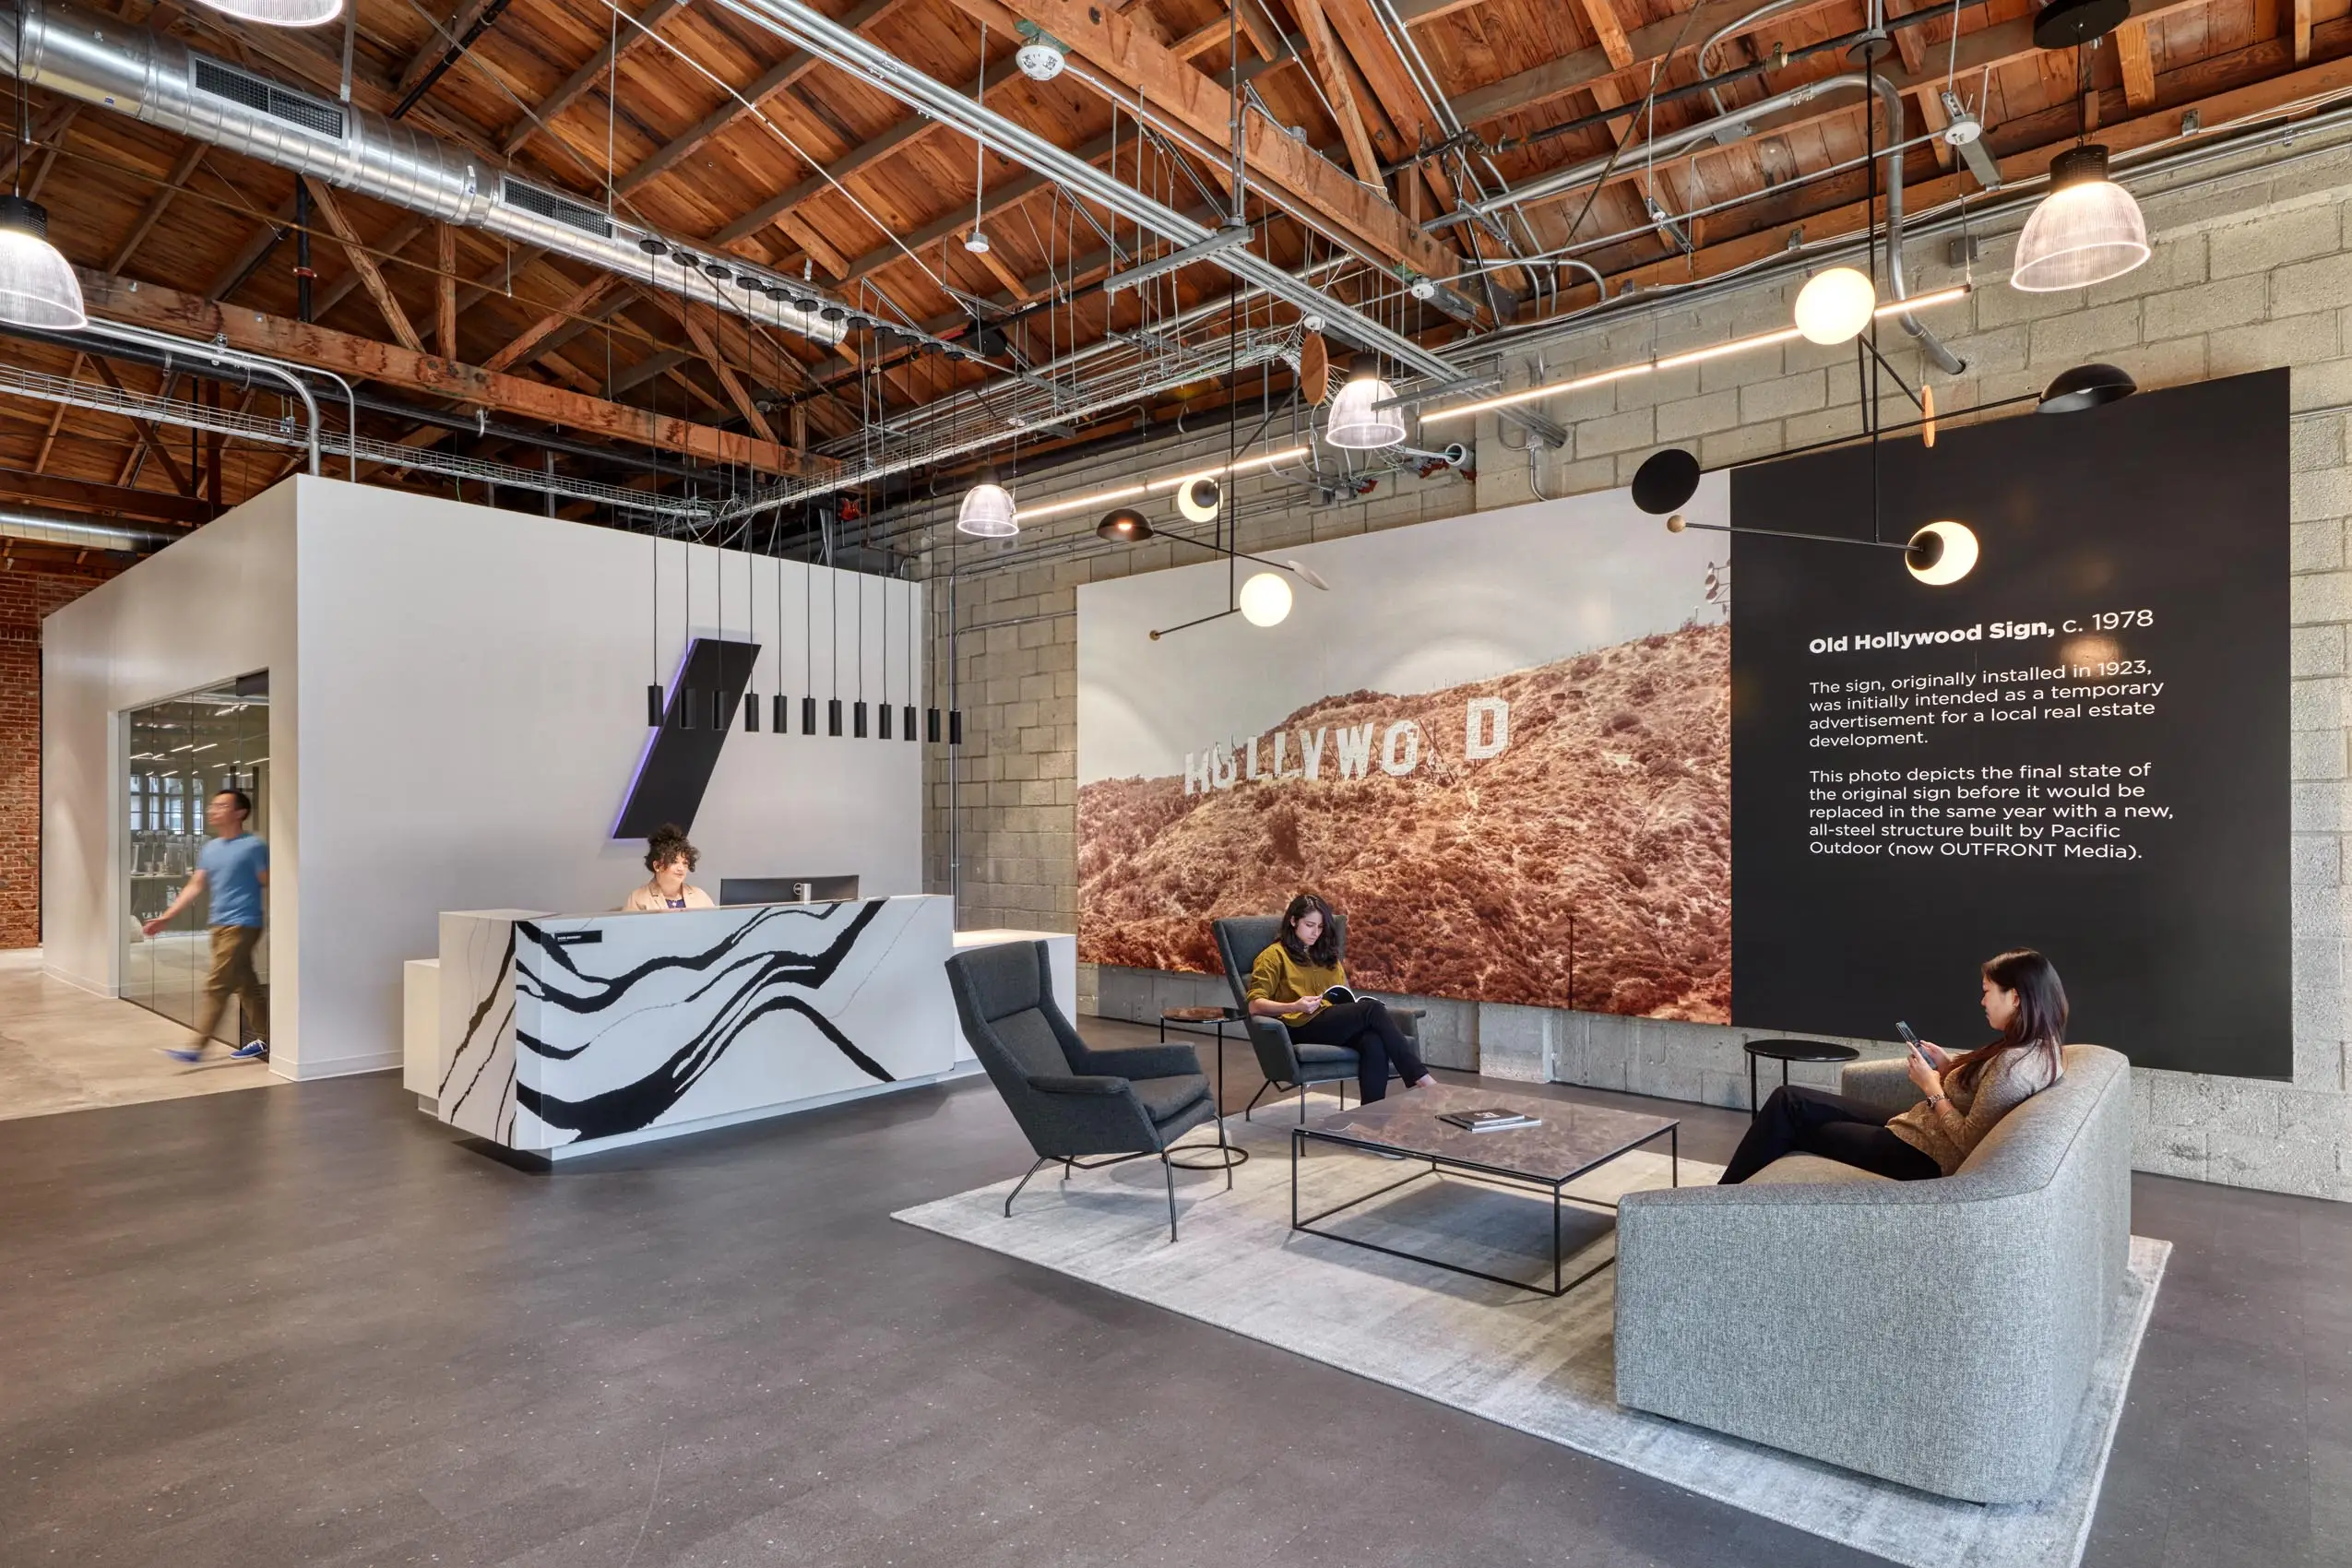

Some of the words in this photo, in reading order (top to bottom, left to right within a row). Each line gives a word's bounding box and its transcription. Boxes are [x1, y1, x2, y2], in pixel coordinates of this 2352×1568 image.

[1809, 635, 1848, 654] Old
[1854, 623, 1983, 651] Hollywood
[1989, 620, 2056, 641] Sign,
[2061, 619, 2084, 634] c.
[2091, 609, 2155, 631] 1978
[1809, 681, 1841, 695] The
[1845, 679, 1886, 694] sign,
[1891, 671, 1977, 691] originally
[1982, 664, 2066, 684] installed
[2073, 663, 2091, 678] in
[2097, 659, 2152, 676] 1923,
[1809, 700, 1842, 712] was
[1847, 694, 1909, 710] initially
[1915, 688, 1999, 707] intended
[2004, 690, 2026, 702] as
[2032, 689, 2044, 700] a
[2050, 682, 2165, 700] temporary
[1809, 711, 1936, 731] advertisement
[1940, 709, 1968, 724] for
[1973, 711, 1985, 723] a
[1990, 706, 2037, 722] local
[2044, 703, 2081, 719] real
[2088, 701, 2156, 718] estate
[1809, 731, 1929, 748] development.
[1809, 769, 1844, 783] This
[1848, 768, 1902, 785] photo
[1906, 766, 1976, 783] depicts
[1980, 765, 2013, 780] the
[2018, 764, 2062, 779] final
[2068, 764, 2122, 778] state
[2128, 761, 2152, 778] of
[1809, 788, 1837, 801] the
[1841, 786, 1907, 802] original
[1912, 786, 1951, 802] sign
[1957, 784, 2021, 800] before
[2026, 784, 2040, 799] it
[2046, 783, 2110, 799] would
[2118, 782, 2145, 798] be
[1809, 804, 1883, 821] replaced
[1889, 804, 1905, 818] in
[1910, 804, 1941, 818] the
[1945, 807, 1997, 818] same
[2002, 806, 2047, 821] year
[2052, 803, 2097, 818] with
[2104, 806, 2117, 818] a
[2124, 806, 2174, 820] new,
[1809, 823, 1875, 837] all-steel
[1881, 824, 1965, 837] structure
[1969, 823, 2013, 837] built
[2019, 823, 2045, 840] by
[2051, 823, 2120, 838] Pacific
[1809, 840, 1883, 855] Outdoor
[1887, 841, 1934, 857] (now
[1940, 842, 2058, 858] OUTFRONT
[2064, 843, 2143, 861] Media).
